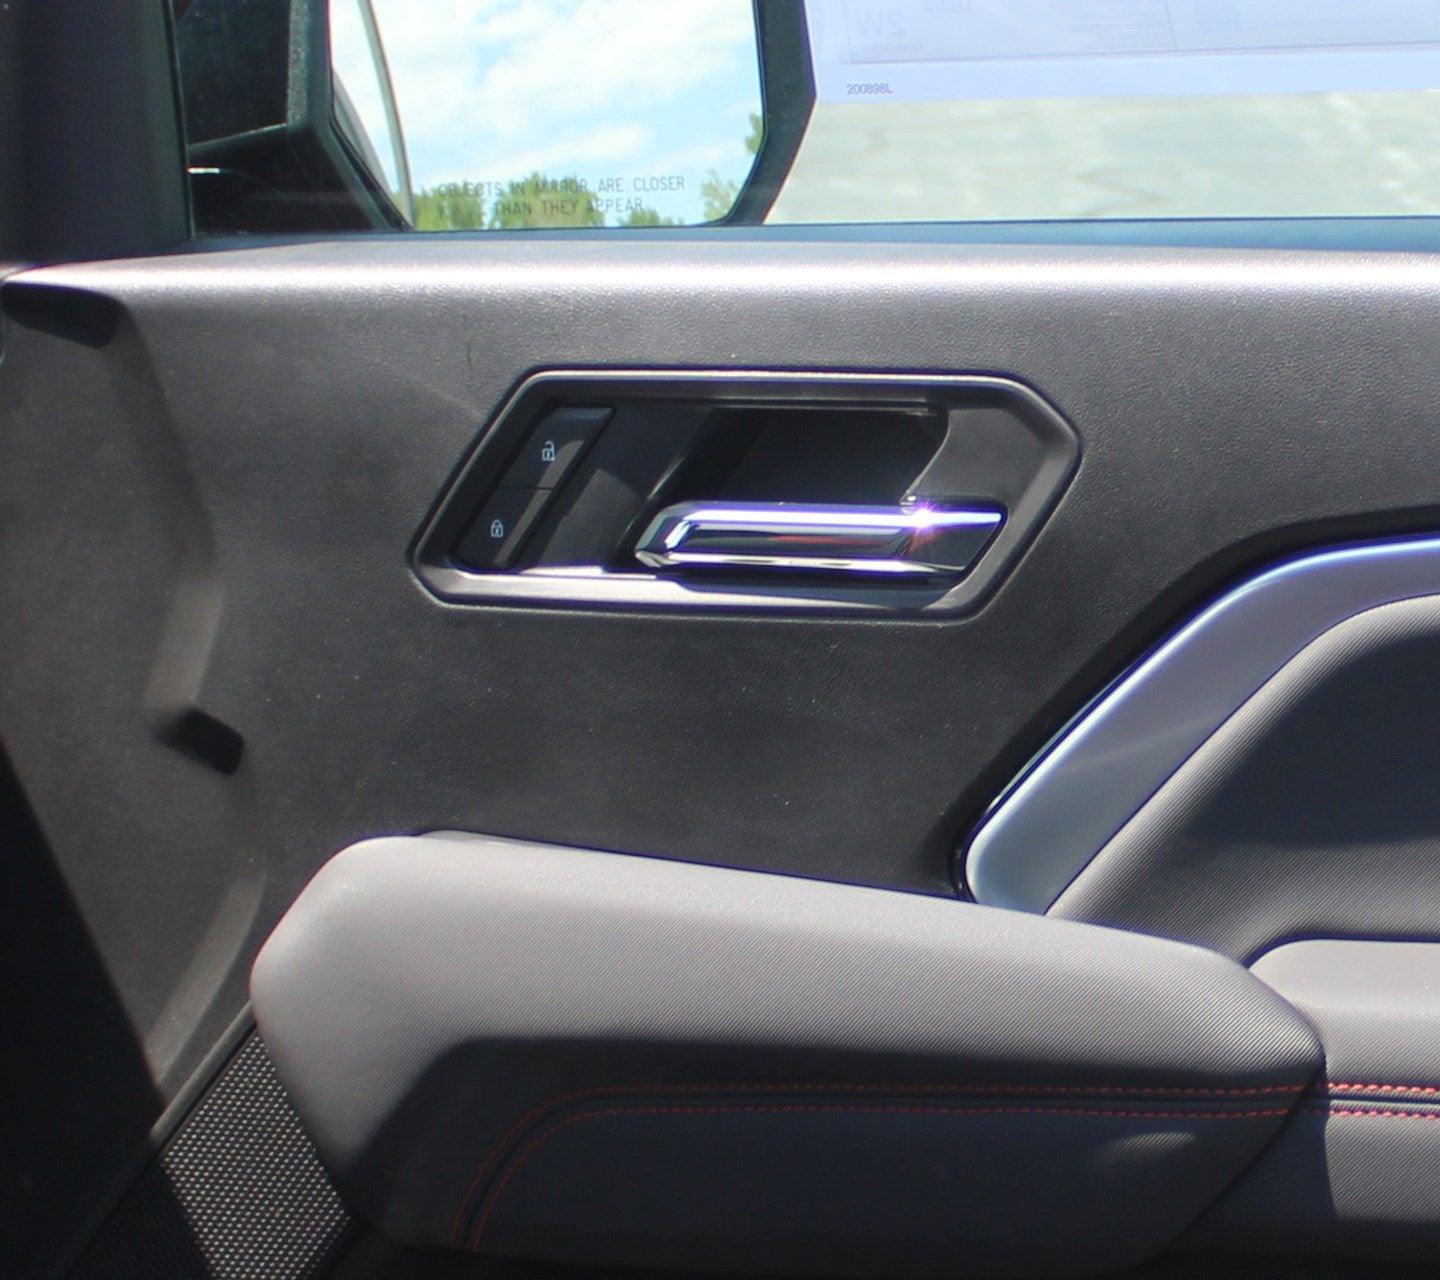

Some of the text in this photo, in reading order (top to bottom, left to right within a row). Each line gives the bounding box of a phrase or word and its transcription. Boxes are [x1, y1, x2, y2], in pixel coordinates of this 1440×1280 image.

[437, 181, 504, 199] OBJECTS
[534, 178, 589, 194] MIRROR
[597, 177, 624, 193] ARE
[633, 175, 687, 192] CLOSER
[493, 197, 645, 216] THAN THEY APPEAR
